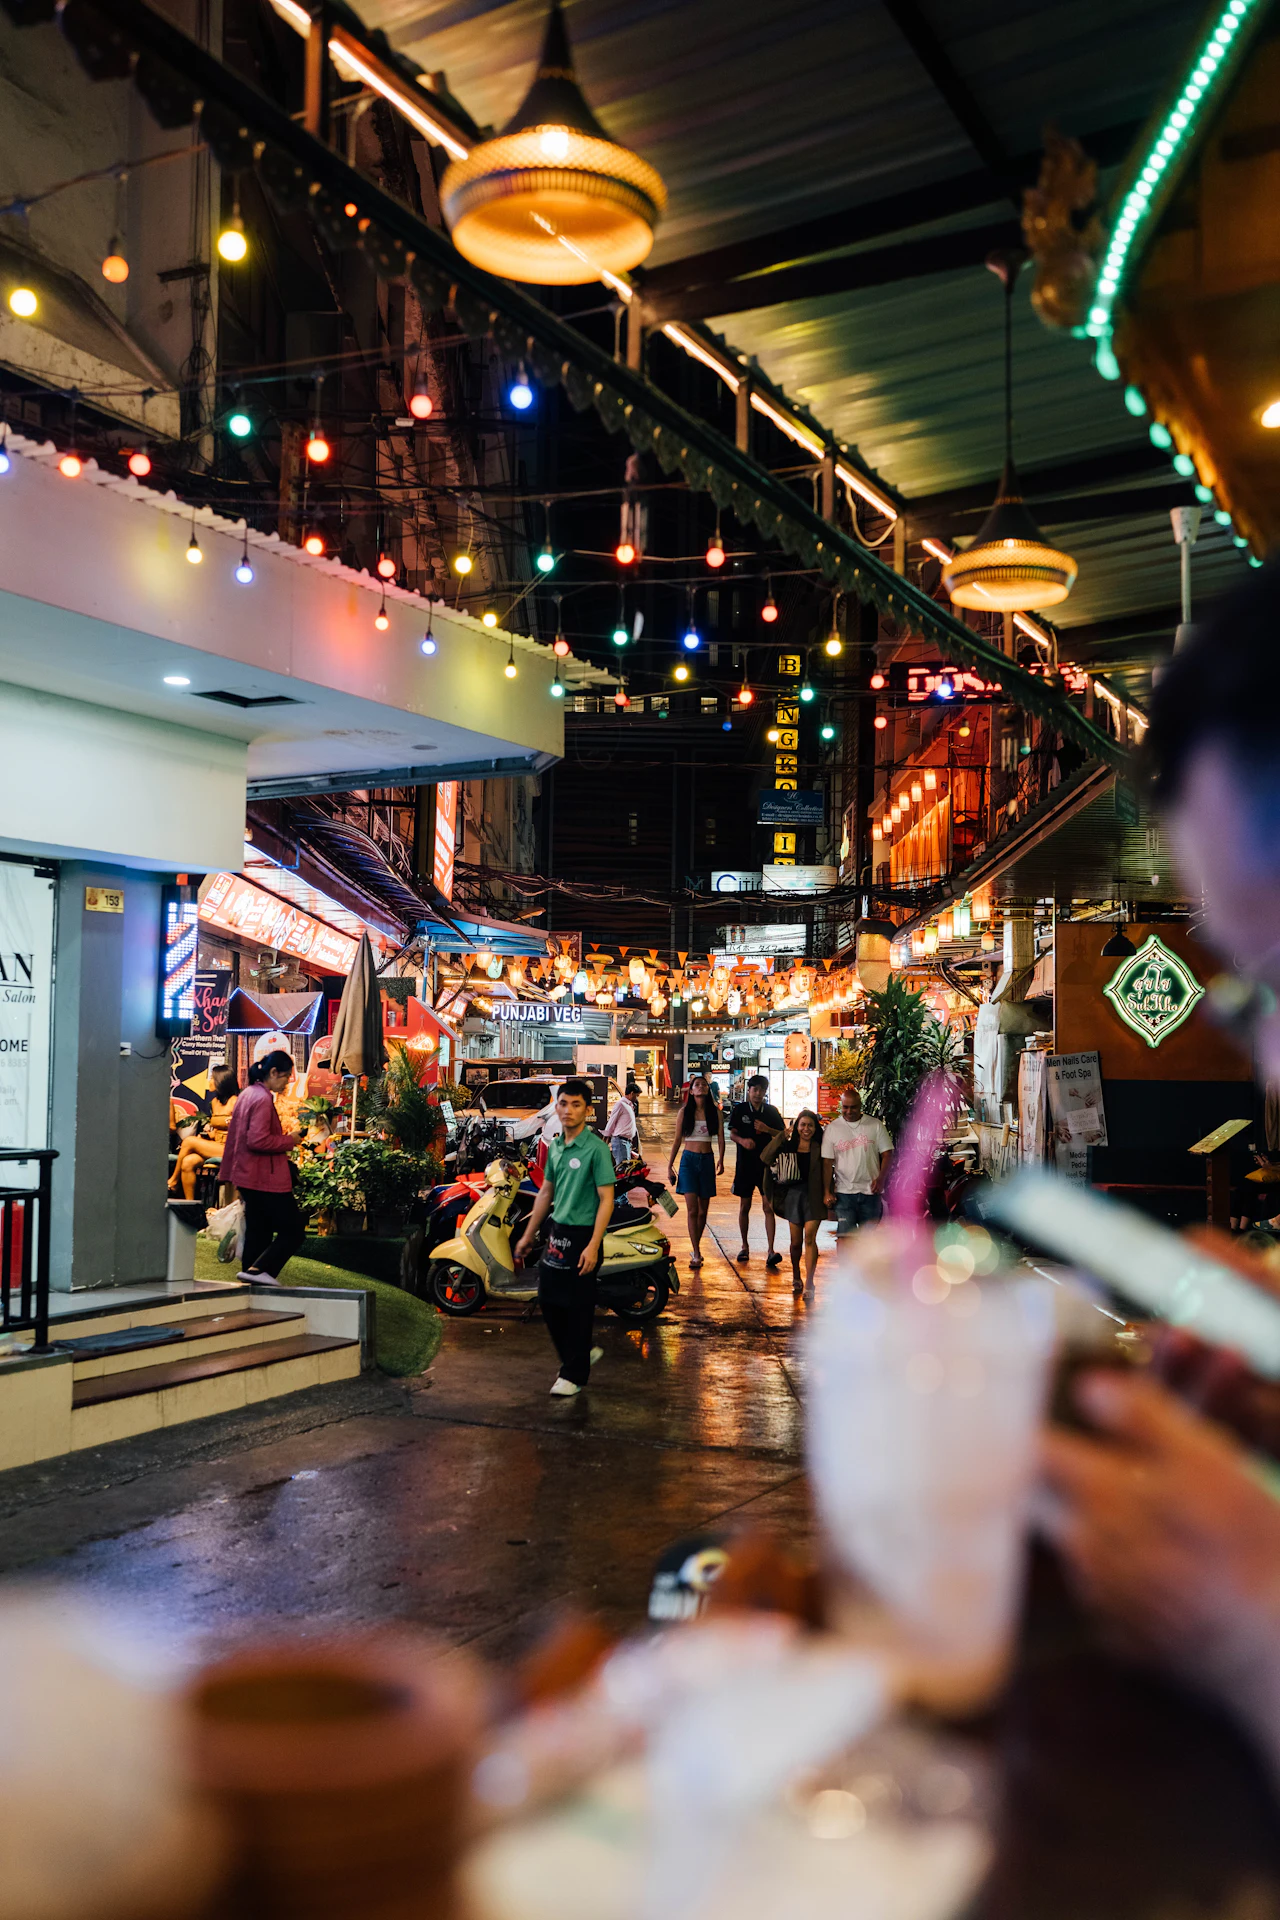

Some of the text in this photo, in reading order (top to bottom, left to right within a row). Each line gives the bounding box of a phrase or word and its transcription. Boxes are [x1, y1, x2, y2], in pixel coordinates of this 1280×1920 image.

[762, 802, 823, 811] Designers Collection
[105, 895, 119, 906] 153
[3, 989, 36, 1003] Salon
[492, 1004, 581, 1022] PUNJABI VEG
[0, 1040, 28, 1052] OME
[1046, 1058, 1061, 1068] Men
[1062, 1056, 1080, 1066] Nails
[1081, 1054, 1098, 1064] Care
[1055, 1068, 1092, 1081] & Foot Spa
